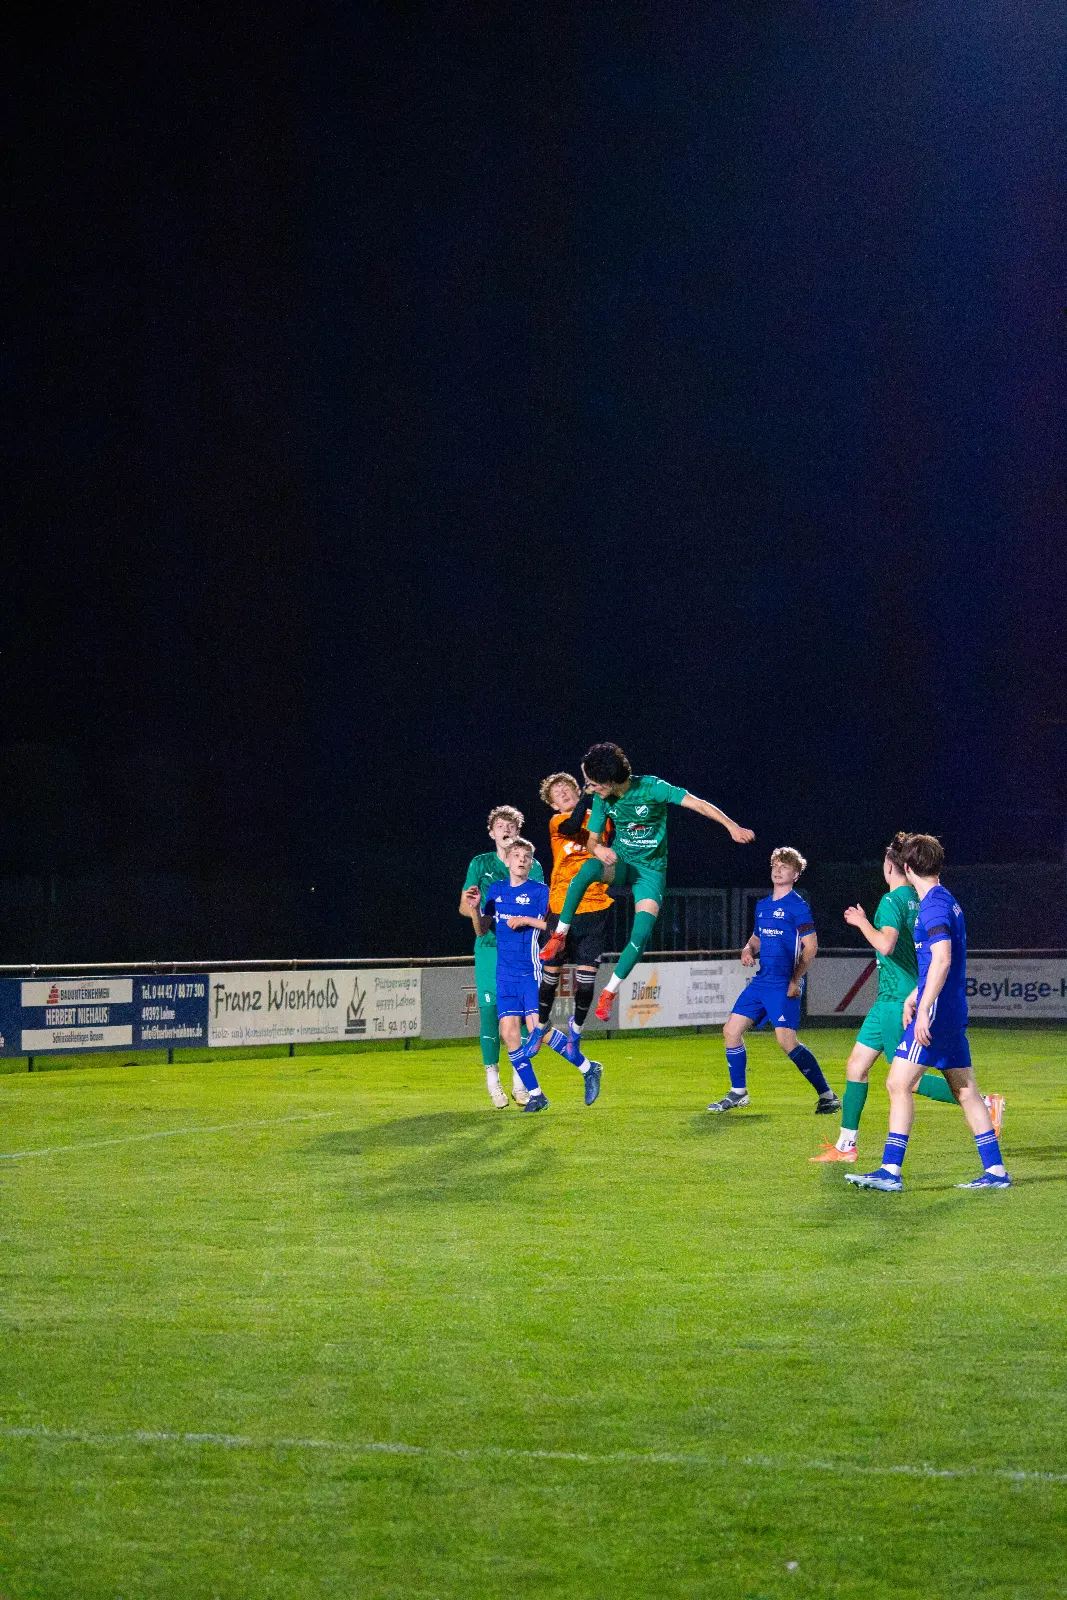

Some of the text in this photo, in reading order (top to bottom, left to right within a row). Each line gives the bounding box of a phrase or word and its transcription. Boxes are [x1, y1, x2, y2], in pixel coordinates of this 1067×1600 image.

[60, 987, 110, 1001] BAUUNTERNEHMEN
[213, 977, 339, 1018] Franz Wienhold
[631, 980, 661, 1000] Blömer
[45, 1006, 109, 1026] HERBERT NIEHAUS
[408, 1017, 418, 1031] 06
